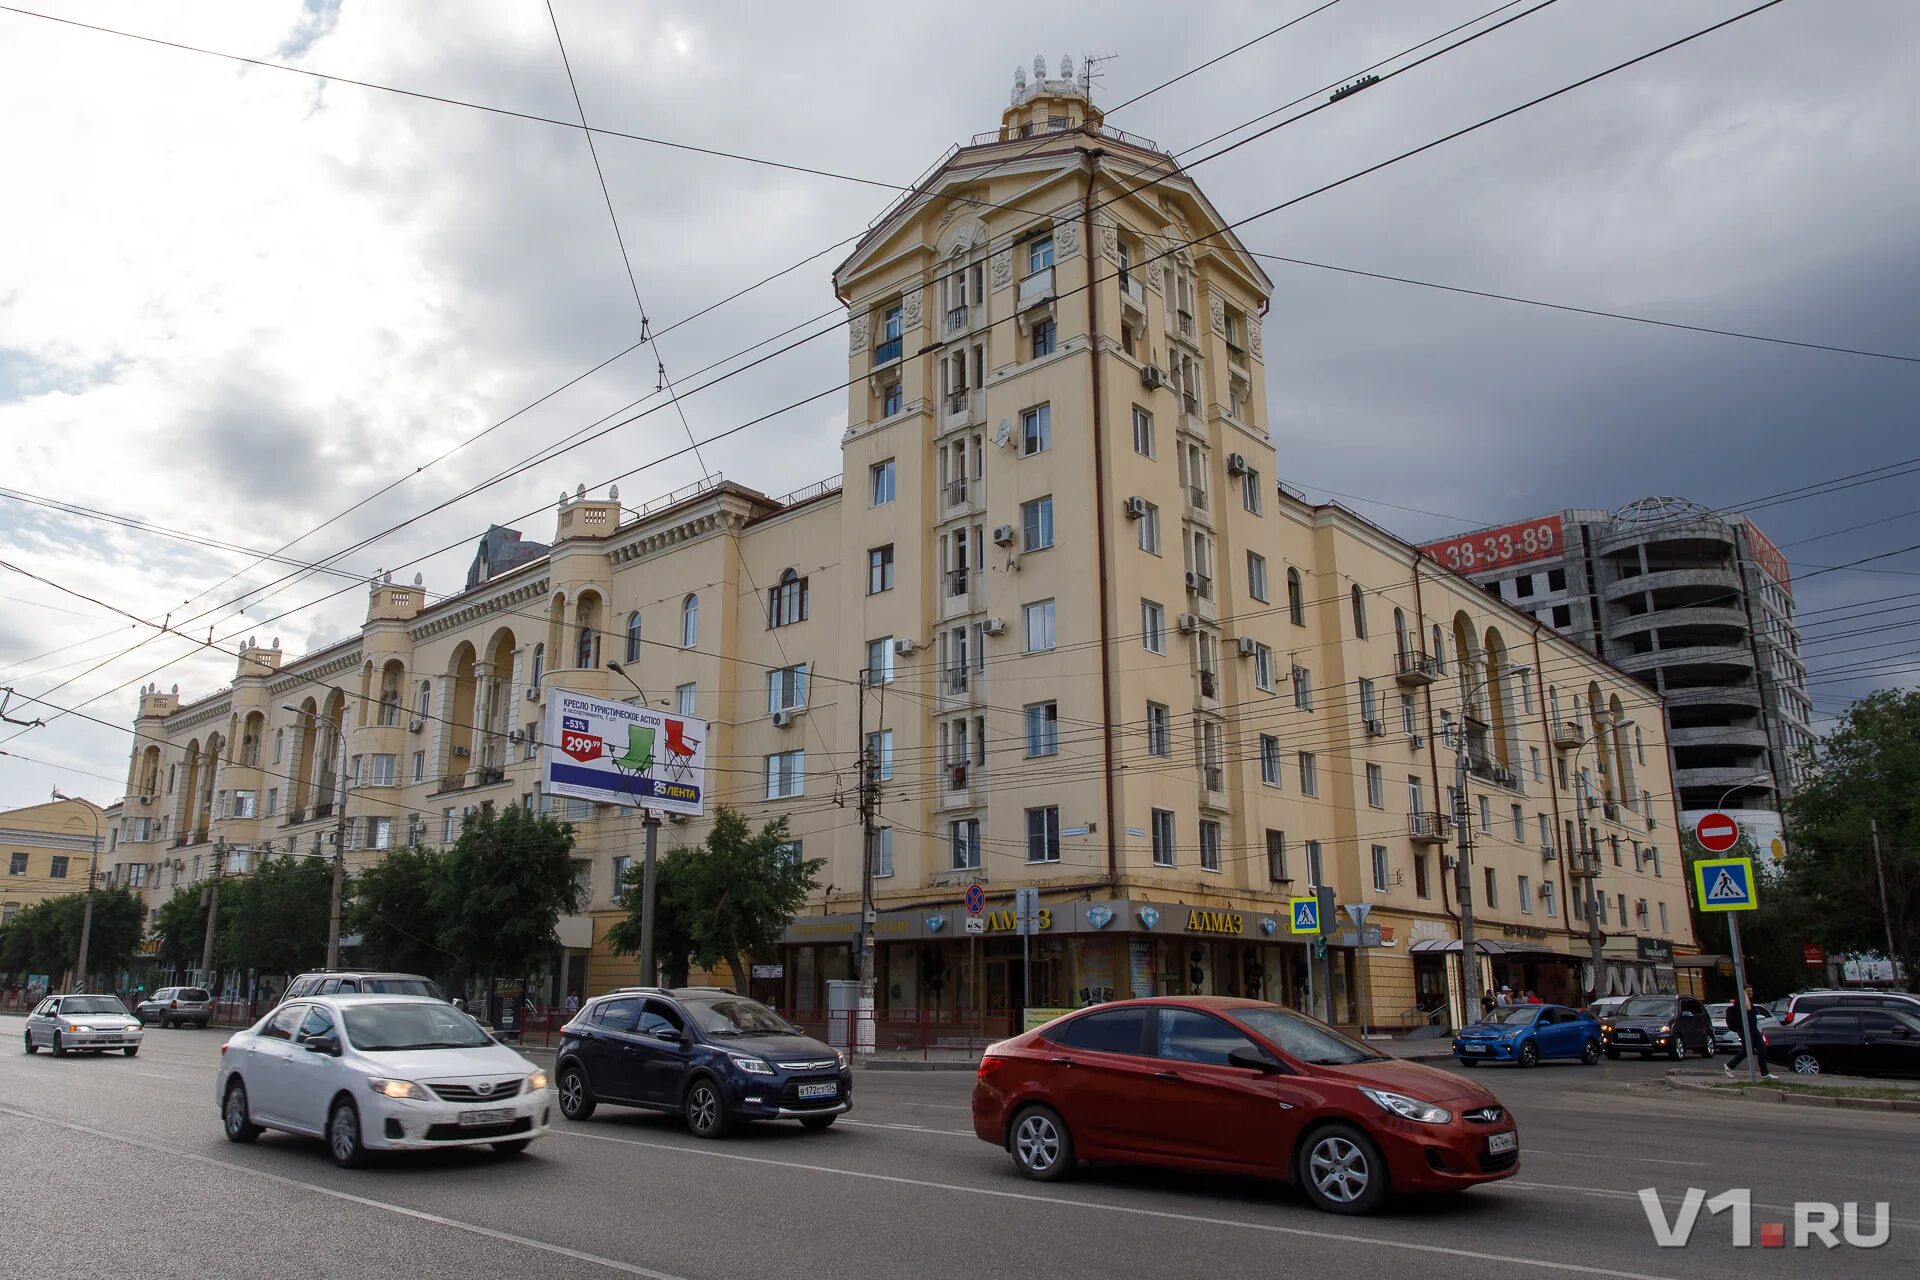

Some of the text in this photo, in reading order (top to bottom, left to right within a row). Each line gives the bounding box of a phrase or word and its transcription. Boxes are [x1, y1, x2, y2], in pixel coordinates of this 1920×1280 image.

[1446, 524, 1554, 569] 38-33-89
[563, 698, 589, 711] КРЕСЛО
[589, 703, 640, 721] ТУРИСТИЧЕСКОЕ
[565, 719, 586, 730] -53%
[666, 785, 696, 799] ЛЕНТА
[983, 908, 1052, 932] ЛМЗ
[1187, 909, 1244, 934] АЛМАЗ
